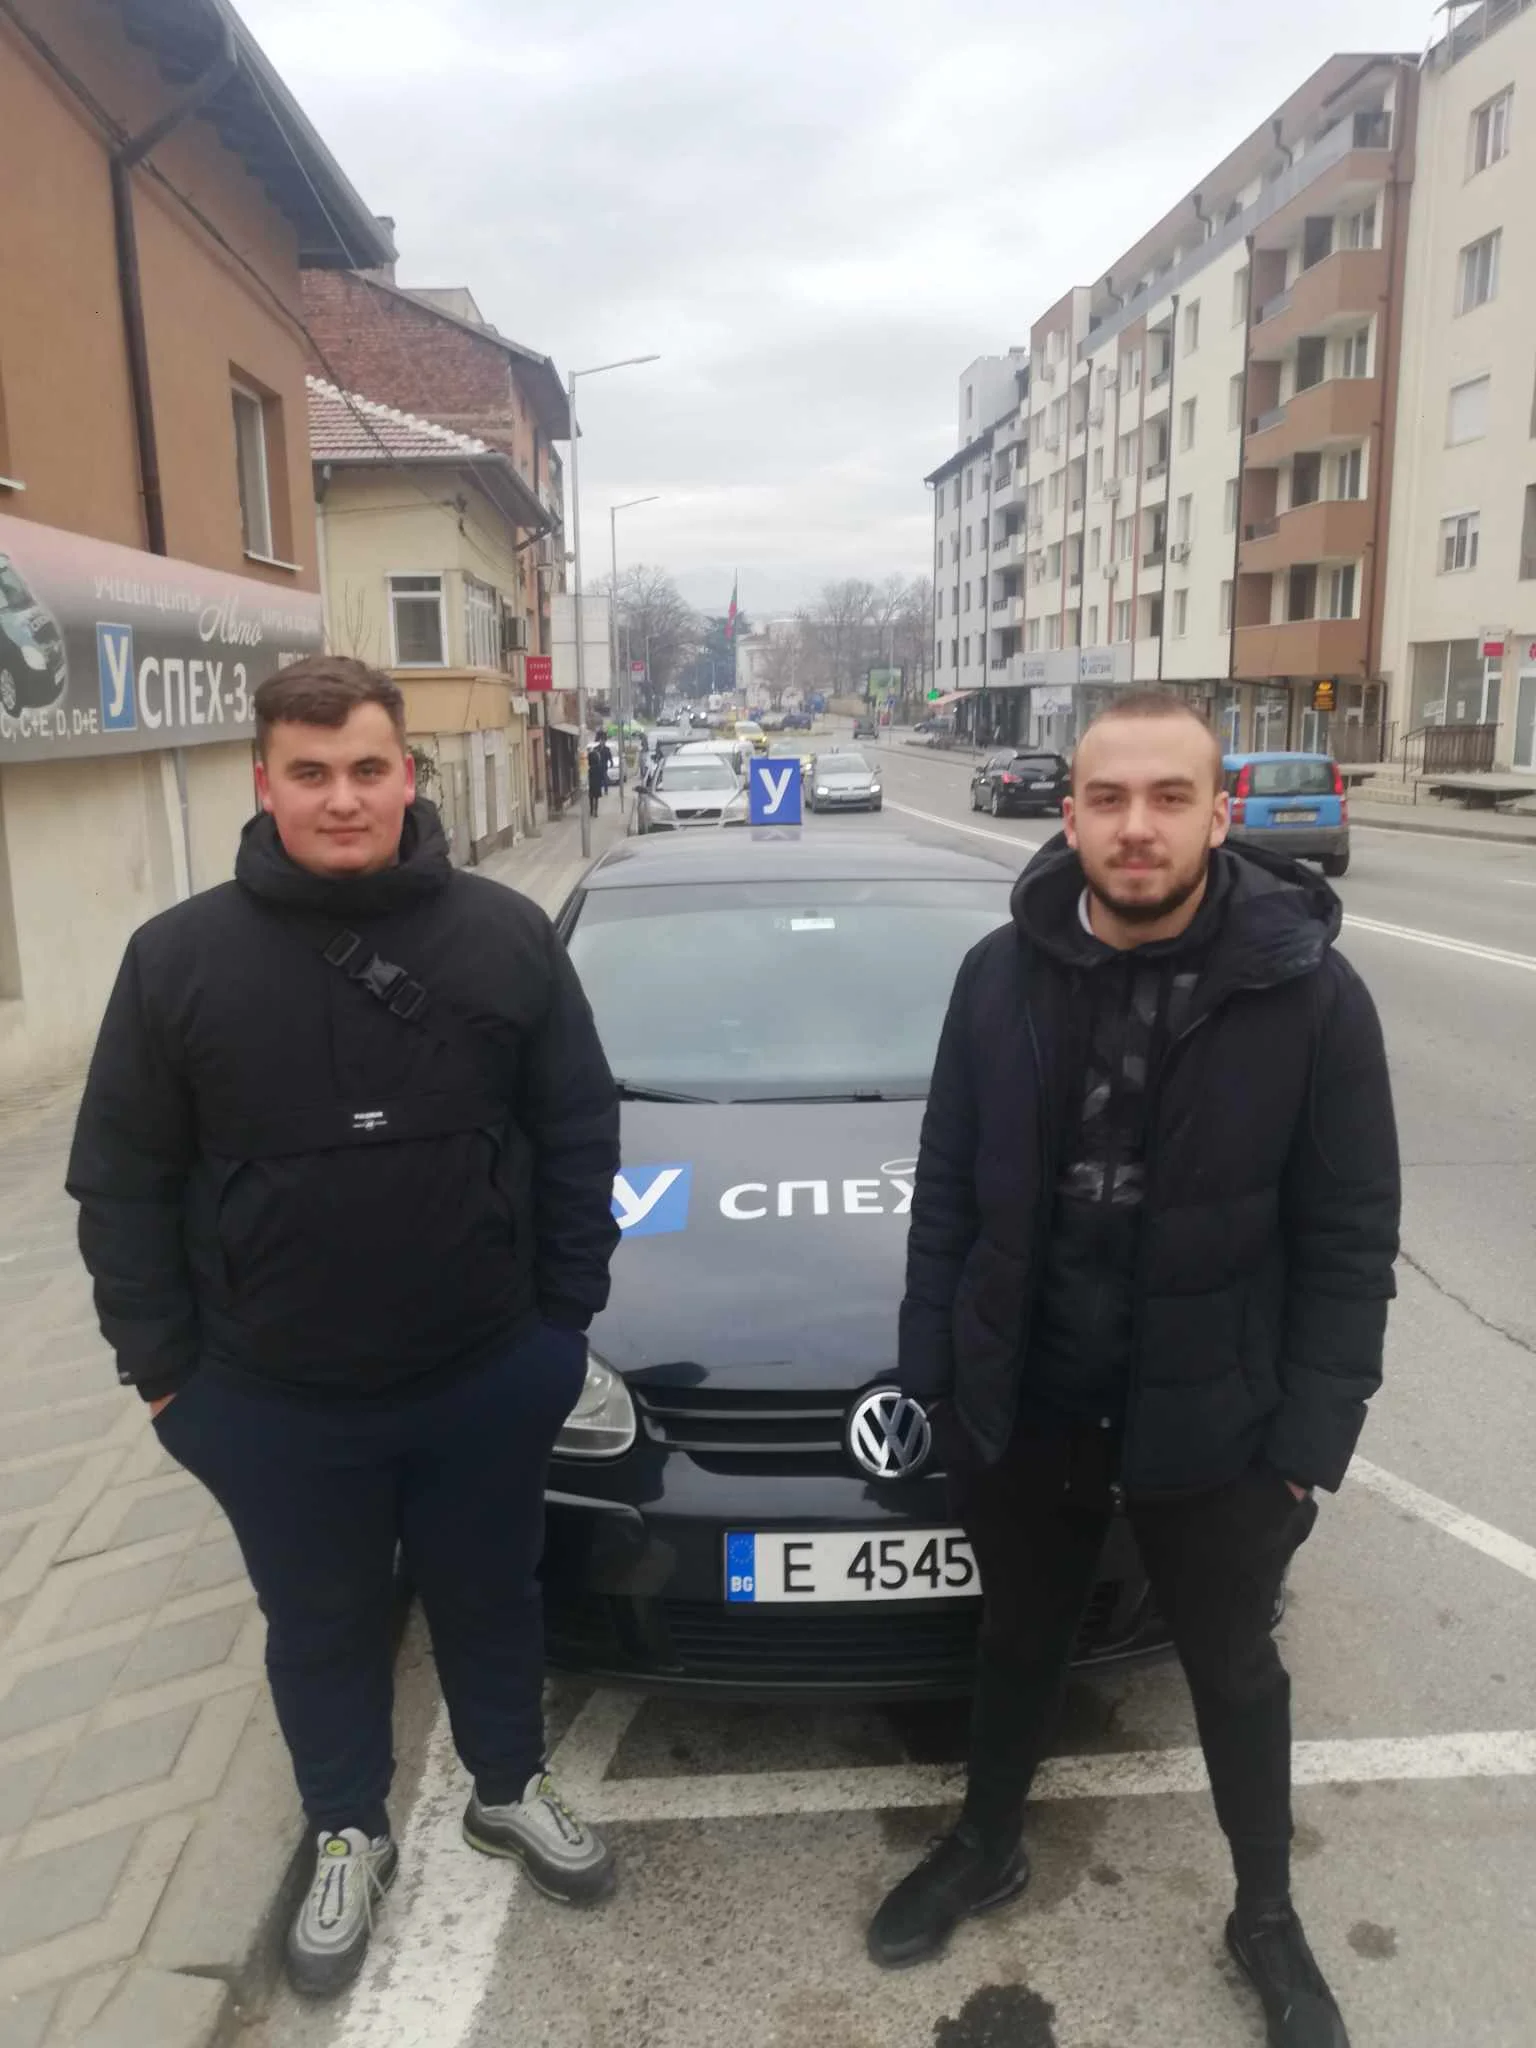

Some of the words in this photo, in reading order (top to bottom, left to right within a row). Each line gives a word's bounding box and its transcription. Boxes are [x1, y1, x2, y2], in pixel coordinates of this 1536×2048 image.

[73, 708, 98, 736] D+E
[758, 768, 793, 815] У
[783, 1542, 815, 1593] E
[846, 1536, 973, 1592] 4545
[730, 1576, 753, 1593] BG
